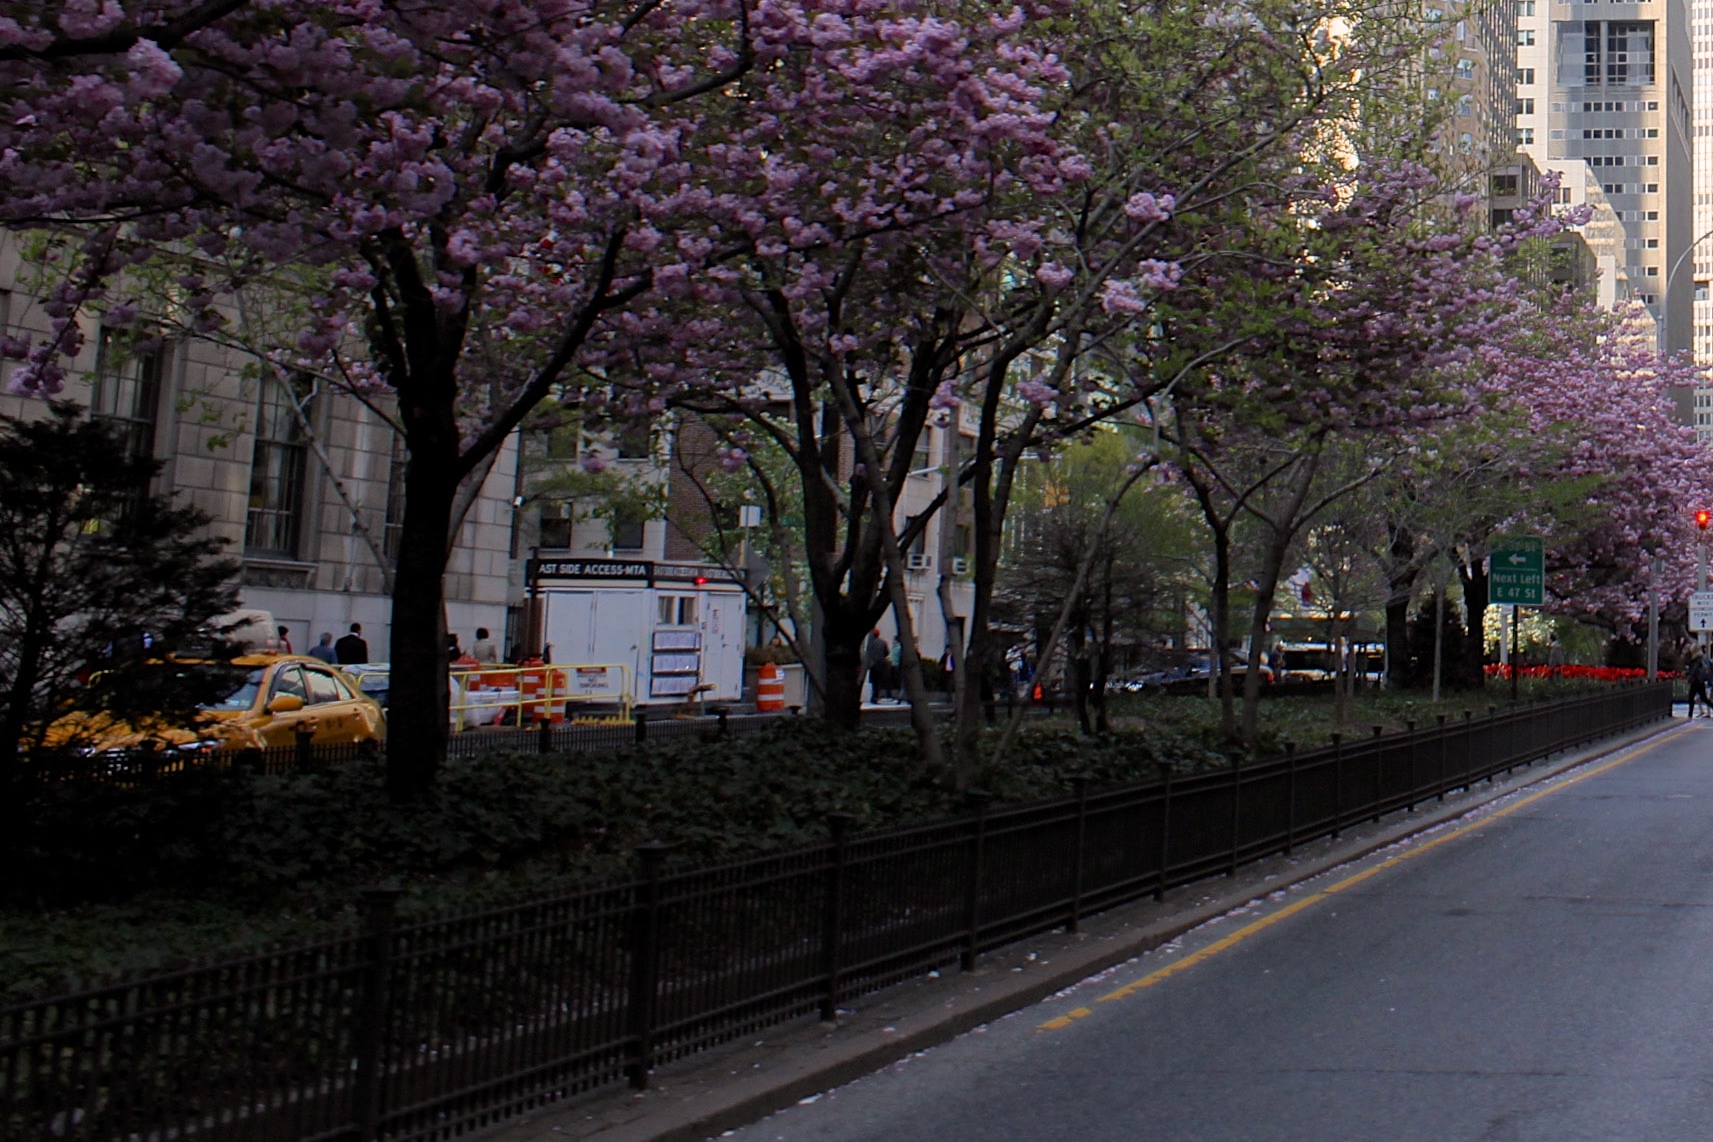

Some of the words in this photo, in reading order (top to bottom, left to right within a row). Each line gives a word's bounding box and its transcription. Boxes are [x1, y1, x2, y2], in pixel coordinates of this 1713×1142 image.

[538, 563, 556, 575] AST
[559, 563, 581, 575] SIDE
[583, 563, 646, 576] ACCESS-MTA
[1492, 572, 1517, 583] Next
[1520, 574, 1541, 585] Left
[1496, 587, 1503, 597] E
[1507, 587, 1520, 598] 47
[1525, 588, 1536, 598] St
